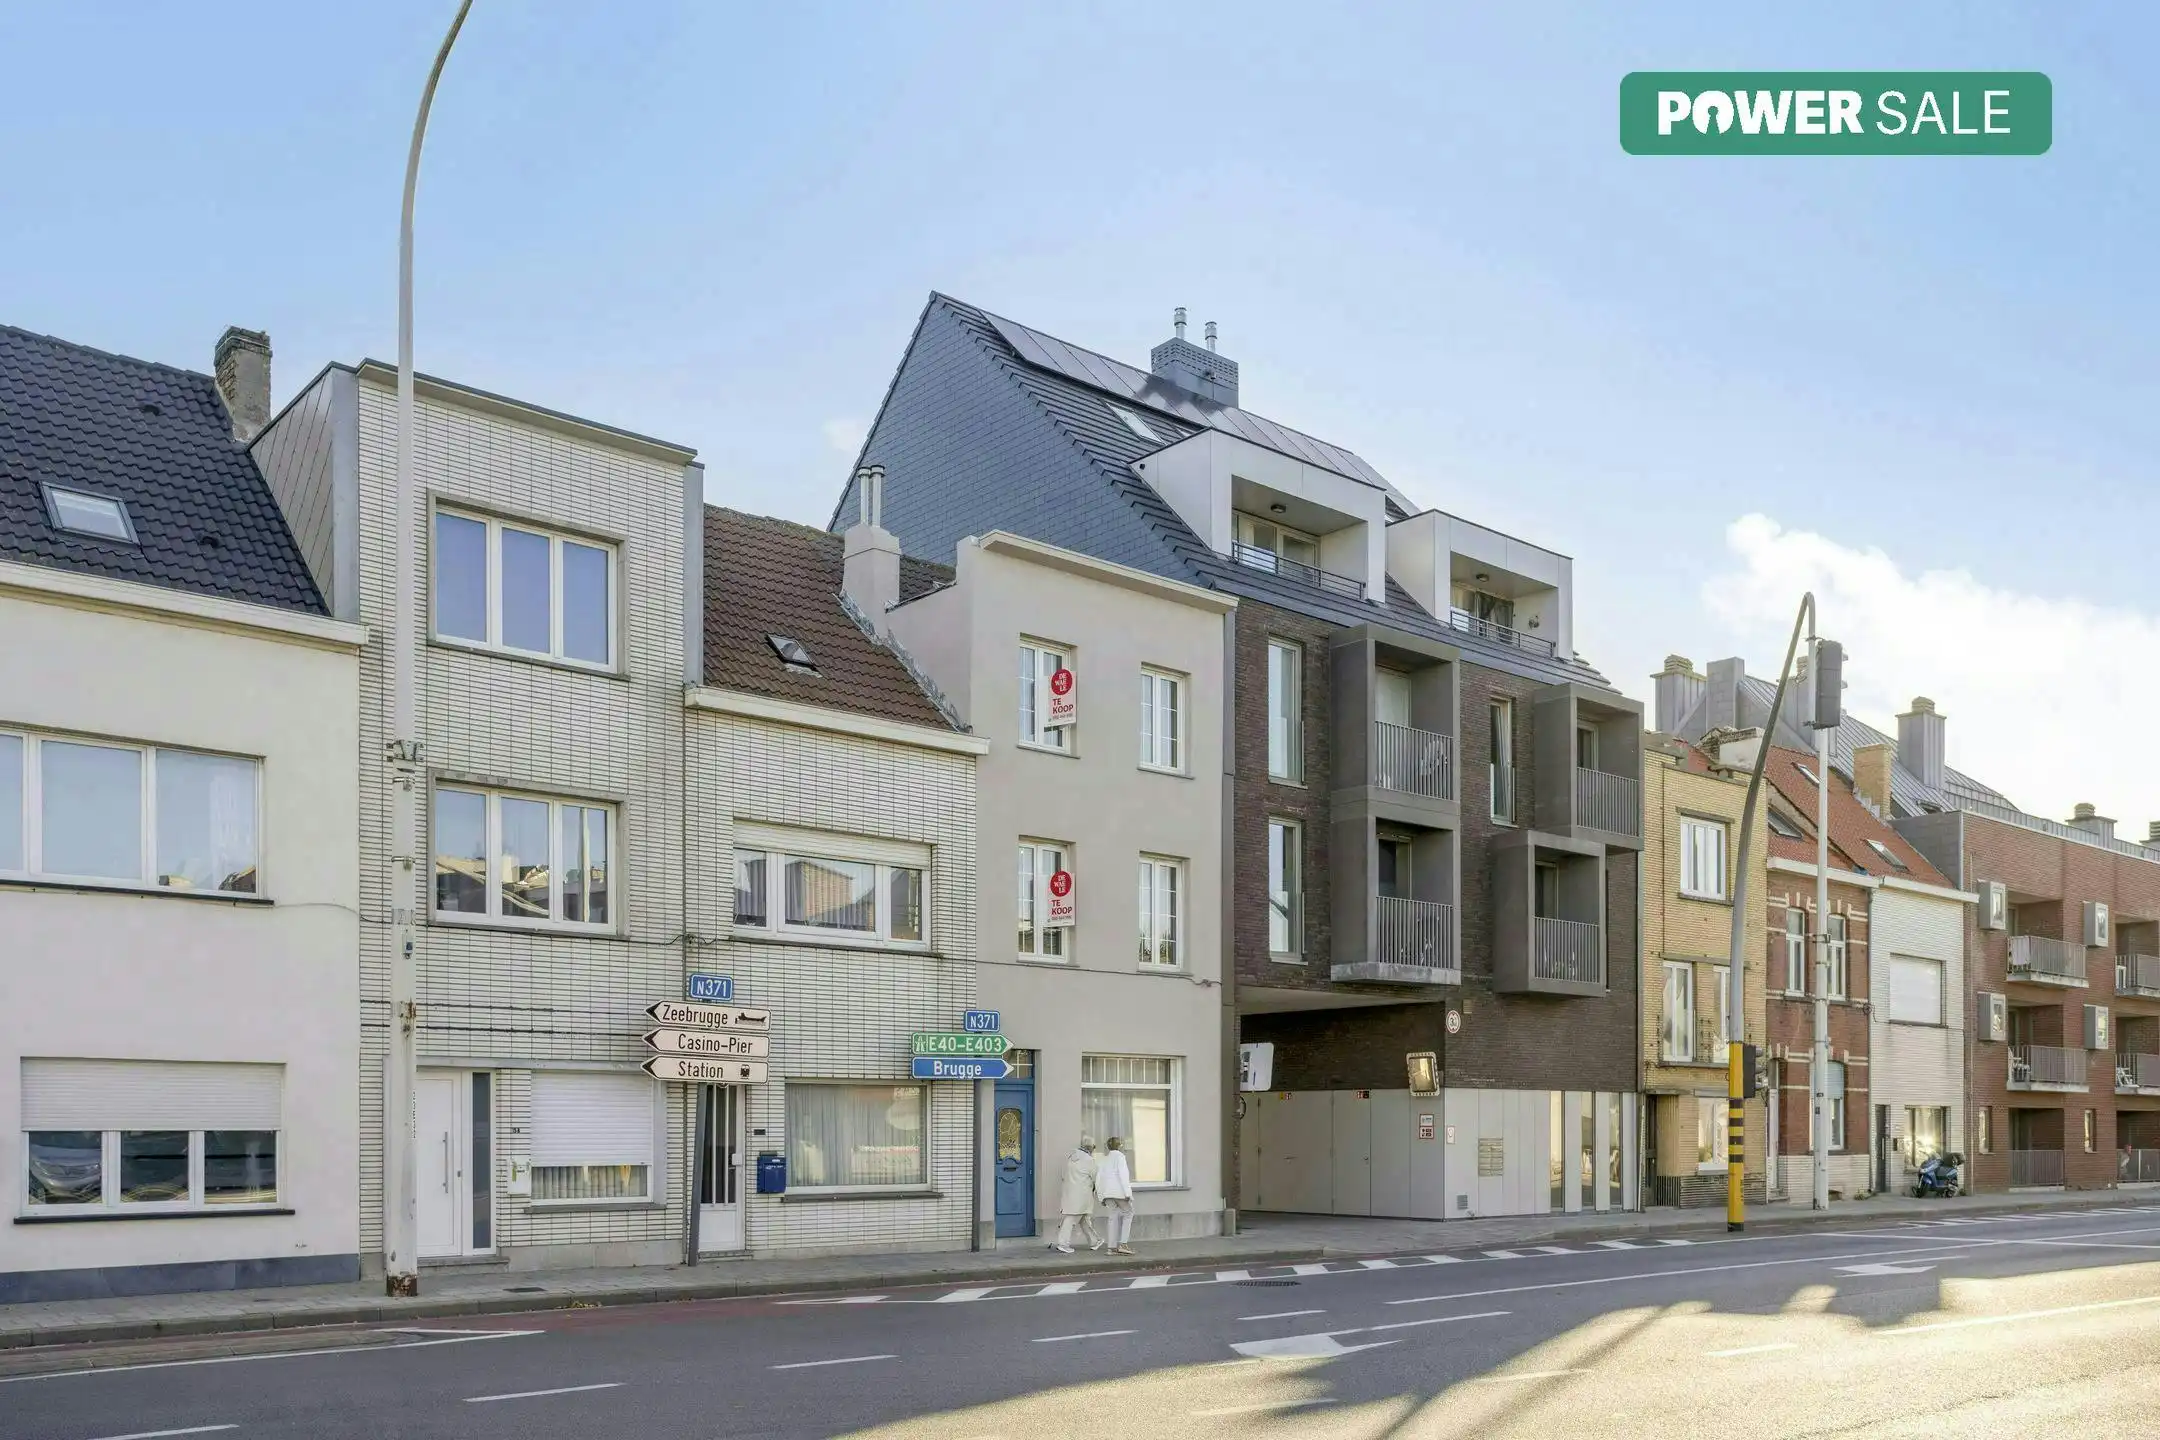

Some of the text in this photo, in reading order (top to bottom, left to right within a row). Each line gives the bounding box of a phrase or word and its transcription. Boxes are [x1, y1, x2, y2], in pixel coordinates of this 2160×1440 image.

[1052, 698, 1062, 706] TE
[1052, 704, 1074, 714] KOOP
[1051, 899, 1061, 907] TE
[1051, 906, 1073, 915] KOOP
[697, 979, 727, 997] N371
[662, 1004, 728, 1029] Zeebrugge
[970, 1013, 995, 1029] N371
[678, 1033, 753, 1054] Casino-Pier
[928, 1036, 1002, 1053] E40-E403
[678, 1060, 724, 1079] Station
[933, 1060, 982, 1079] Brugge
